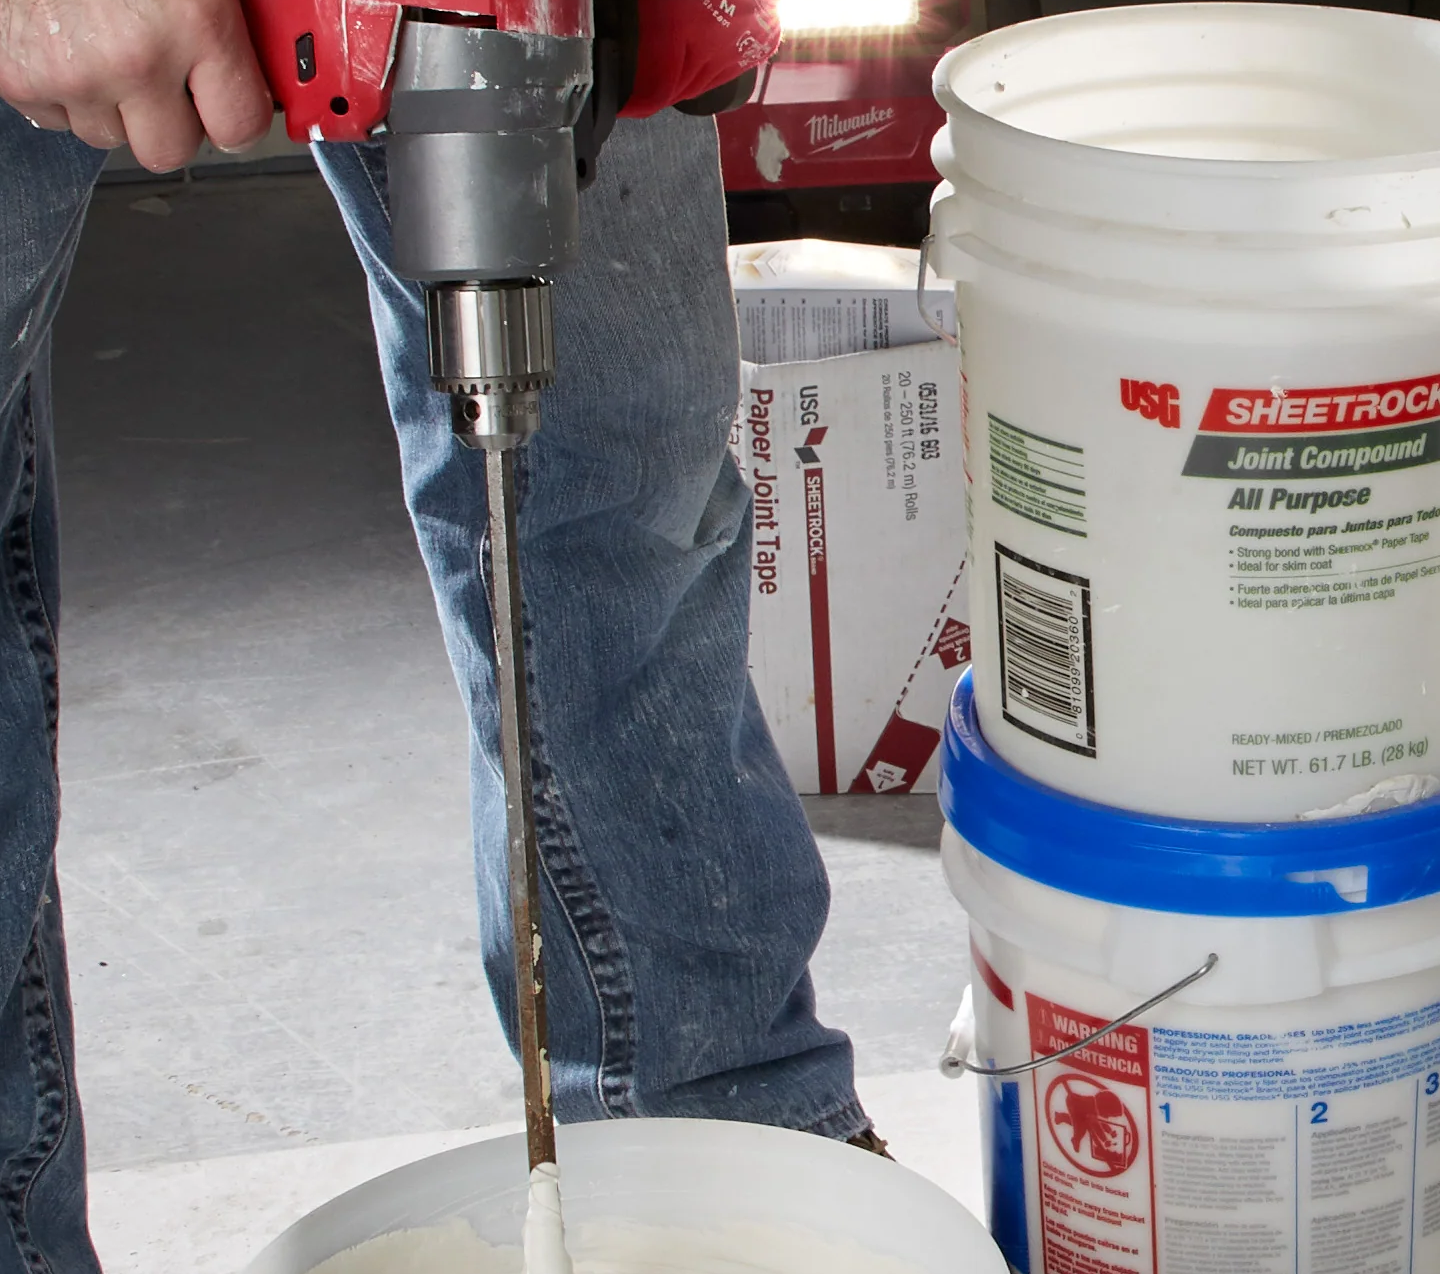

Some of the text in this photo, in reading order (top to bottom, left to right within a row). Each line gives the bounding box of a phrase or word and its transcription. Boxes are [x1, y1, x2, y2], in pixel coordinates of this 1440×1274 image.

[804, 106, 895, 145] Milwaukee
[800, 385, 819, 425] USG
[918, 382, 939, 436] 05/31/16
[1120, 378, 1180, 429] USG
[898, 371, 918, 522] 20 250 ft (76.2 m) Rolls
[1227, 433, 1427, 471] Joint Compound
[747, 388, 781, 596] Paper Joint Tape
[1227, 485, 1372, 514] All Purpose
[1229, 524, 1304, 540] Compuesto
[1306, 524, 1338, 539] para
[1341, 518, 1384, 534] Juntas
[1386, 513, 1413, 531] para
[1237, 546, 1272, 561] Strong
[1274, 546, 1301, 559] bond
[1303, 545, 1325, 557] with
[1381, 535, 1409, 550] Paper
[1409, 530, 1430, 545] Tape
[1237, 558, 1333, 572] Ideal for skim coat
[1237, 583, 1271, 596] Fuerte
[1333, 580, 1351, 592] con
[1381, 574, 1392, 586] de
[1394, 568, 1419, 583] Papel
[1237, 597, 1262, 609] Ideal
[1265, 599, 1288, 611] para
[1328, 594, 1338, 606] la
[1340, 589, 1371, 604] última
[1373, 588, 1396, 601] capa
[954, 646, 966, 662] 2
[1068, 615, 1080, 664] 20360
[1069, 667, 1083, 715] 81099
[1232, 718, 1404, 745] READY-MIXED PREMEZCLADO
[1232, 736, 1429, 776] NET WT. 61.7 LB. (28 kg)
[1152, 1027, 1233, 1041] PROFESSIONAL
[1154, 1065, 1218, 1078] GRADO/USO
[1221, 1069, 1297, 1079] PROFESIONAL
[1158, 1102, 1171, 1124] 1
[1310, 1101, 1328, 1125] 2
[1424, 1071, 1440, 1095] 3
